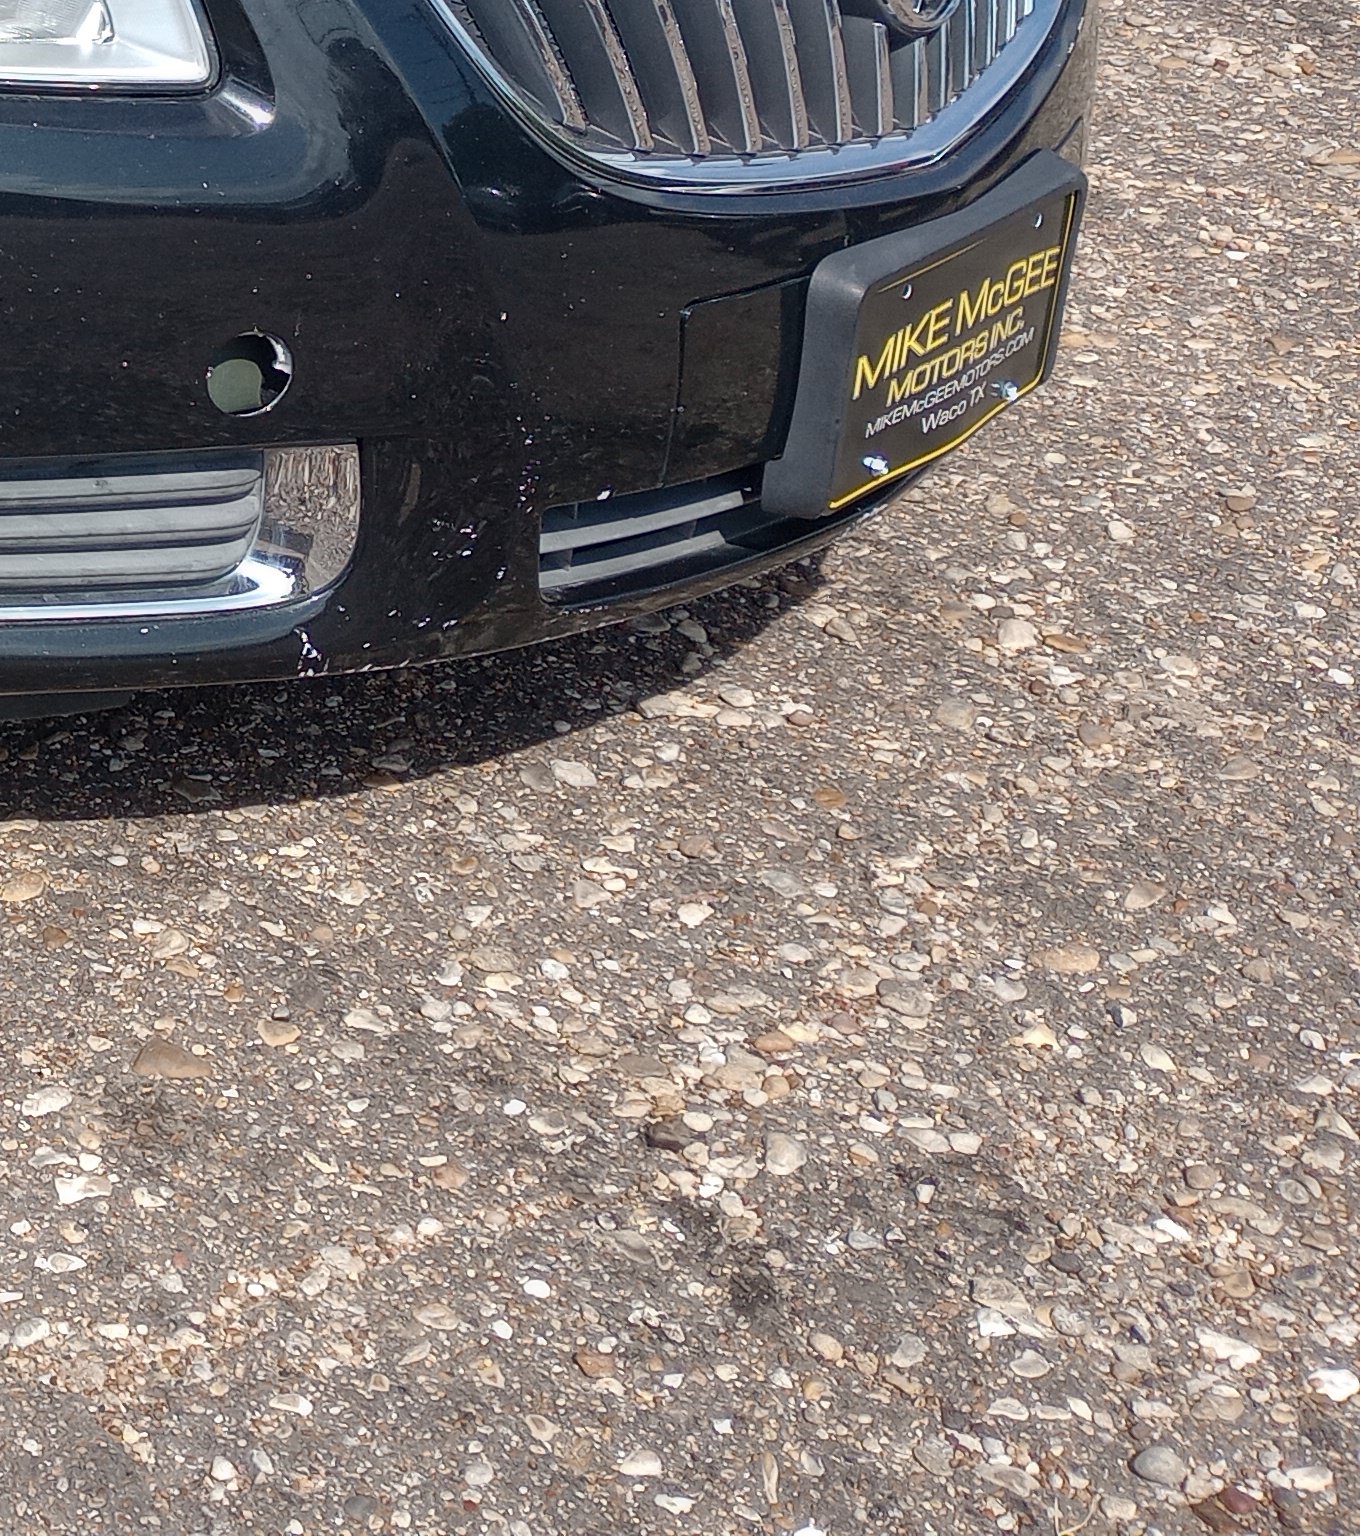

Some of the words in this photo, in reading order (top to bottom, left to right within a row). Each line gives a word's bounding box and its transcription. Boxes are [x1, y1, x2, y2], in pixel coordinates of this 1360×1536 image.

[852, 297, 954, 401] MIKE
[955, 245, 1062, 337] McGEE
[885, 330, 989, 408] MOTORS
[921, 399, 967, 435] Waco
[969, 381, 988, 408] TX
